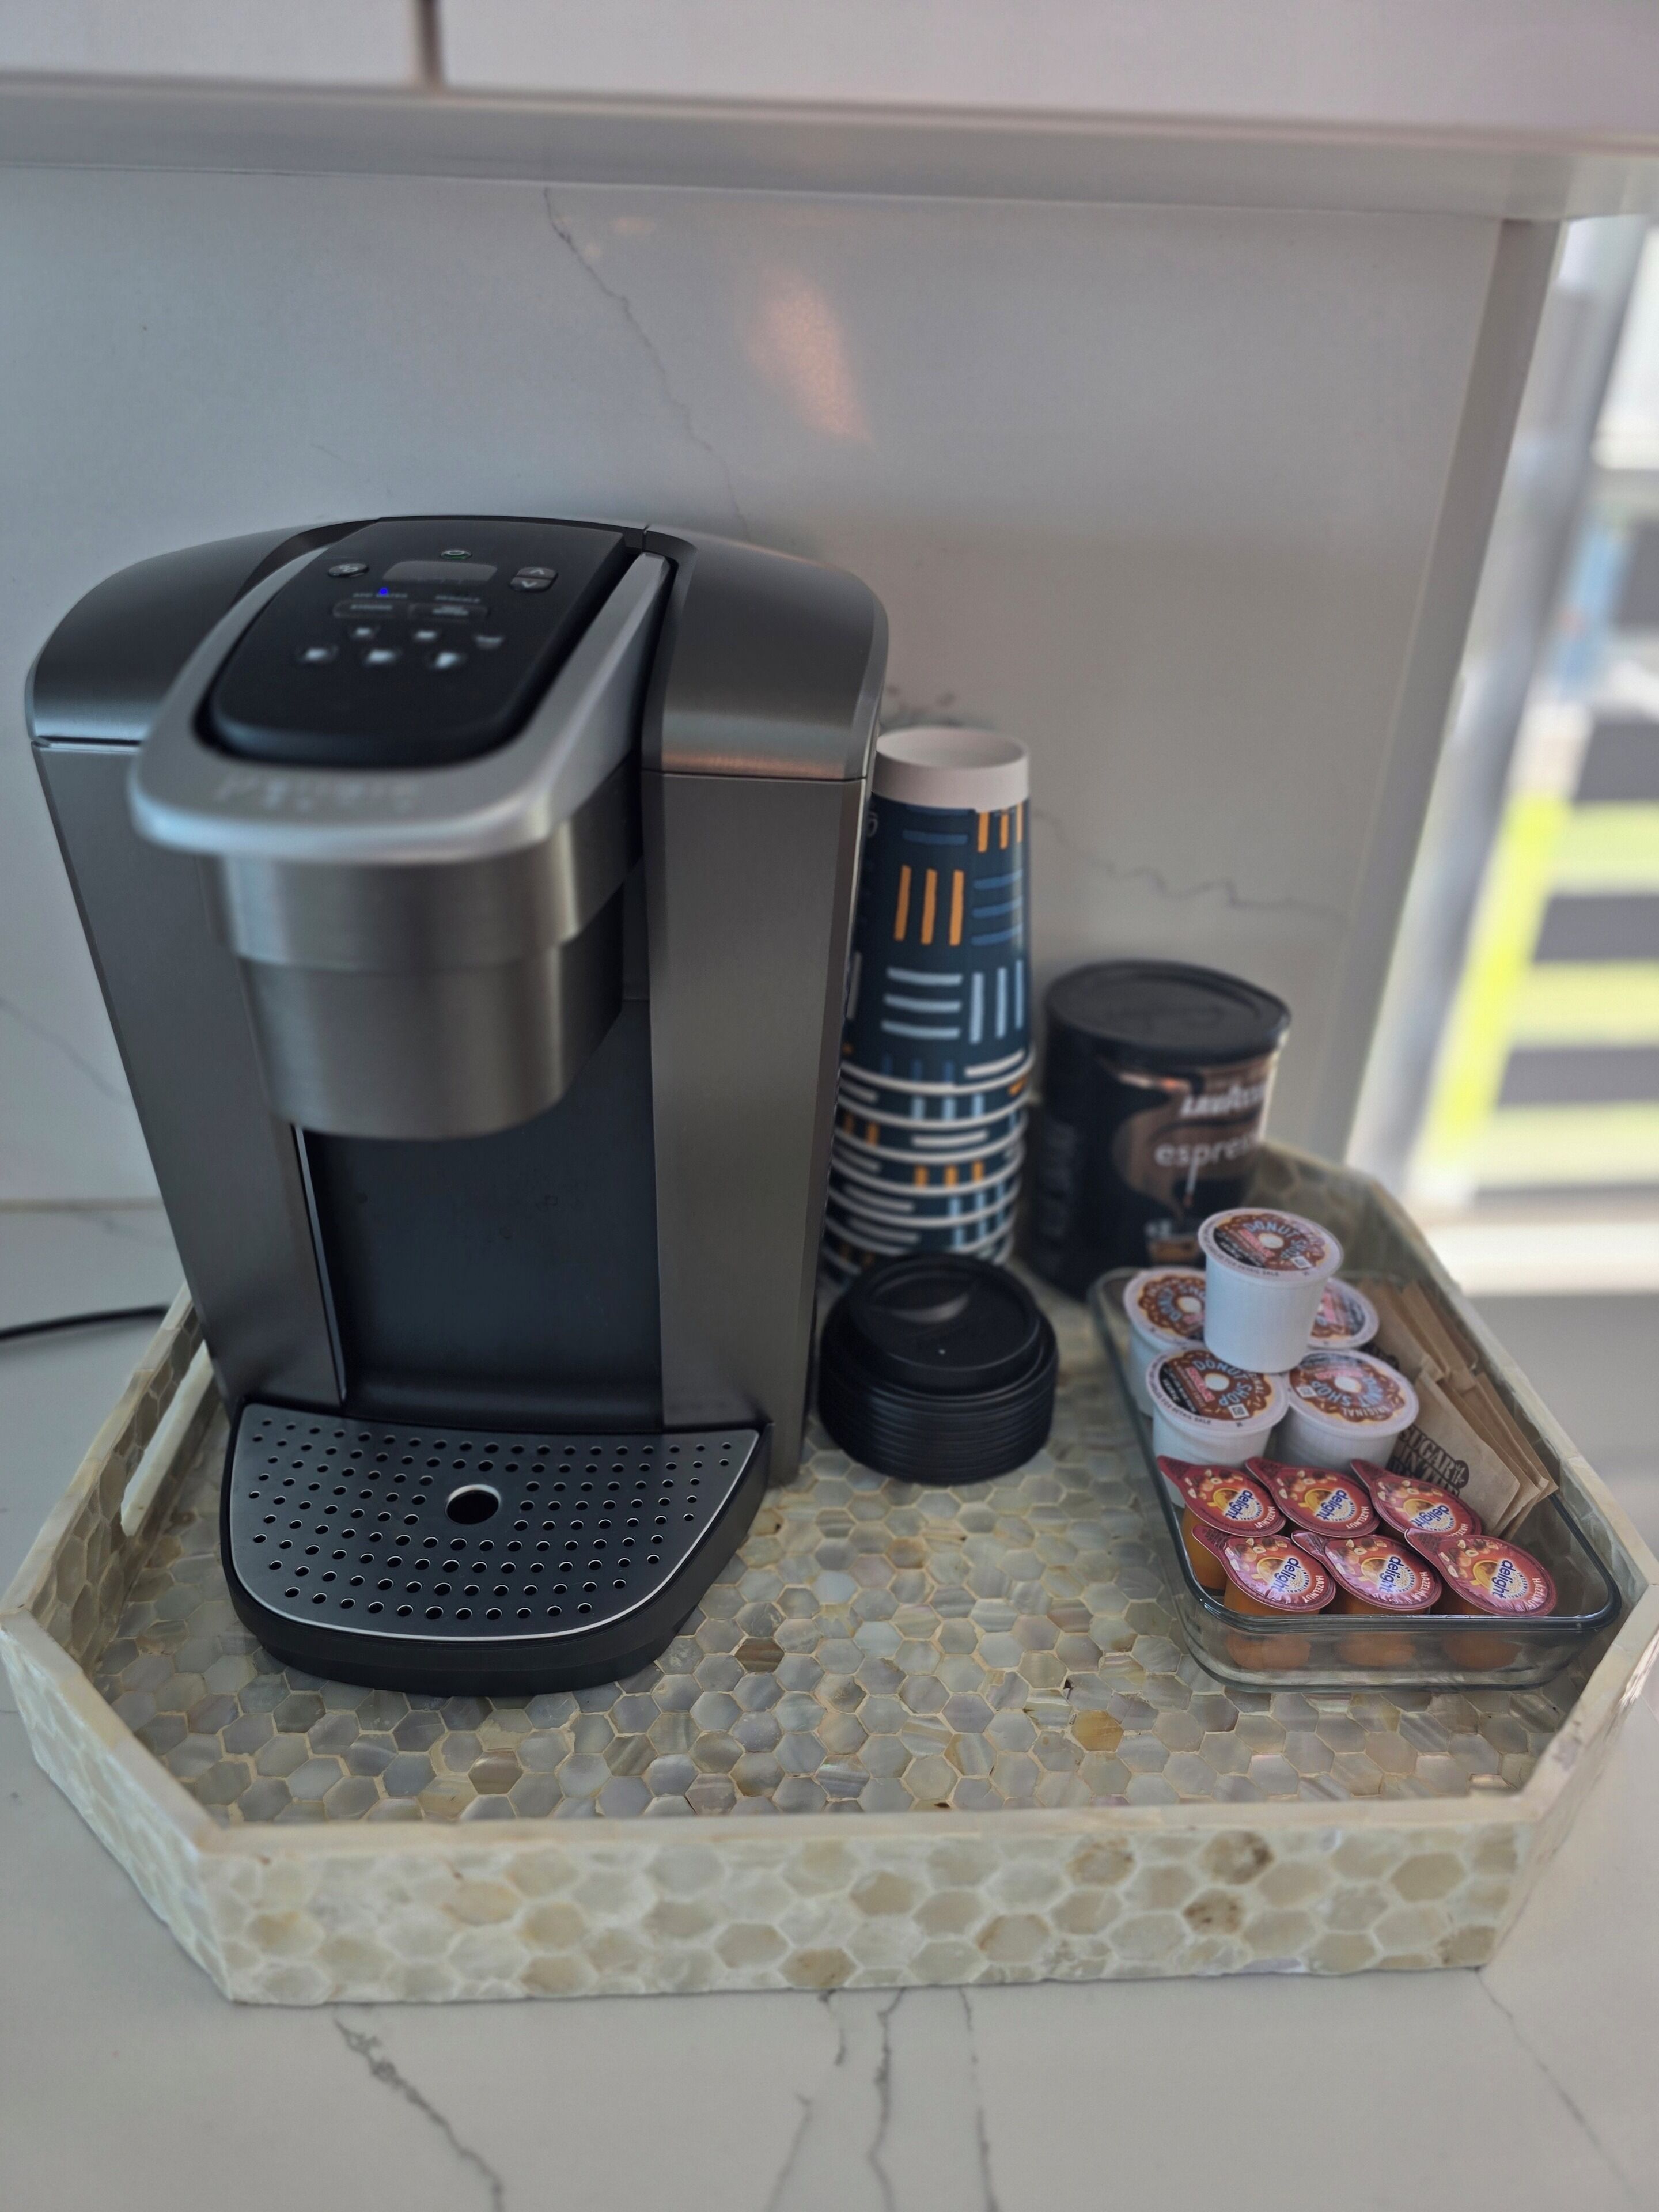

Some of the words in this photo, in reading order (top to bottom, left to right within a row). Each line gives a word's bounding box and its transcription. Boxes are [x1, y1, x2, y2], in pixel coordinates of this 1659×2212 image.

[1242, 1219, 1301, 1237] DONUT
[1280, 1238, 1308, 1259] SHOP
[1192, 1359, 1249, 1380] DONUT
[1218, 1382, 1252, 1406] SHOP
[1310, 1381, 1351, 1406] SHOP
[1399, 1424, 1456, 1480] SUGAR
[1225, 1490, 1254, 1520] delight
[1254, 1506, 1275, 1529] HAZELNUT
[1316, 1489, 1349, 1520] delight
[1346, 1506, 1369, 1529] HAZELNUT
[1410, 1505, 1450, 1528] delight
[1448, 1523, 1468, 1537] HAZEL
[1271, 1557, 1301, 1593] delight
[1302, 1575, 1325, 1603] HAZELNUT
[1379, 1556, 1404, 1594] delight
[1412, 1571, 1431, 1601] HAZELNUT
[1491, 1560, 1517, 1599] delight
[1527, 1577, 1546, 1610] HAZELNUT
